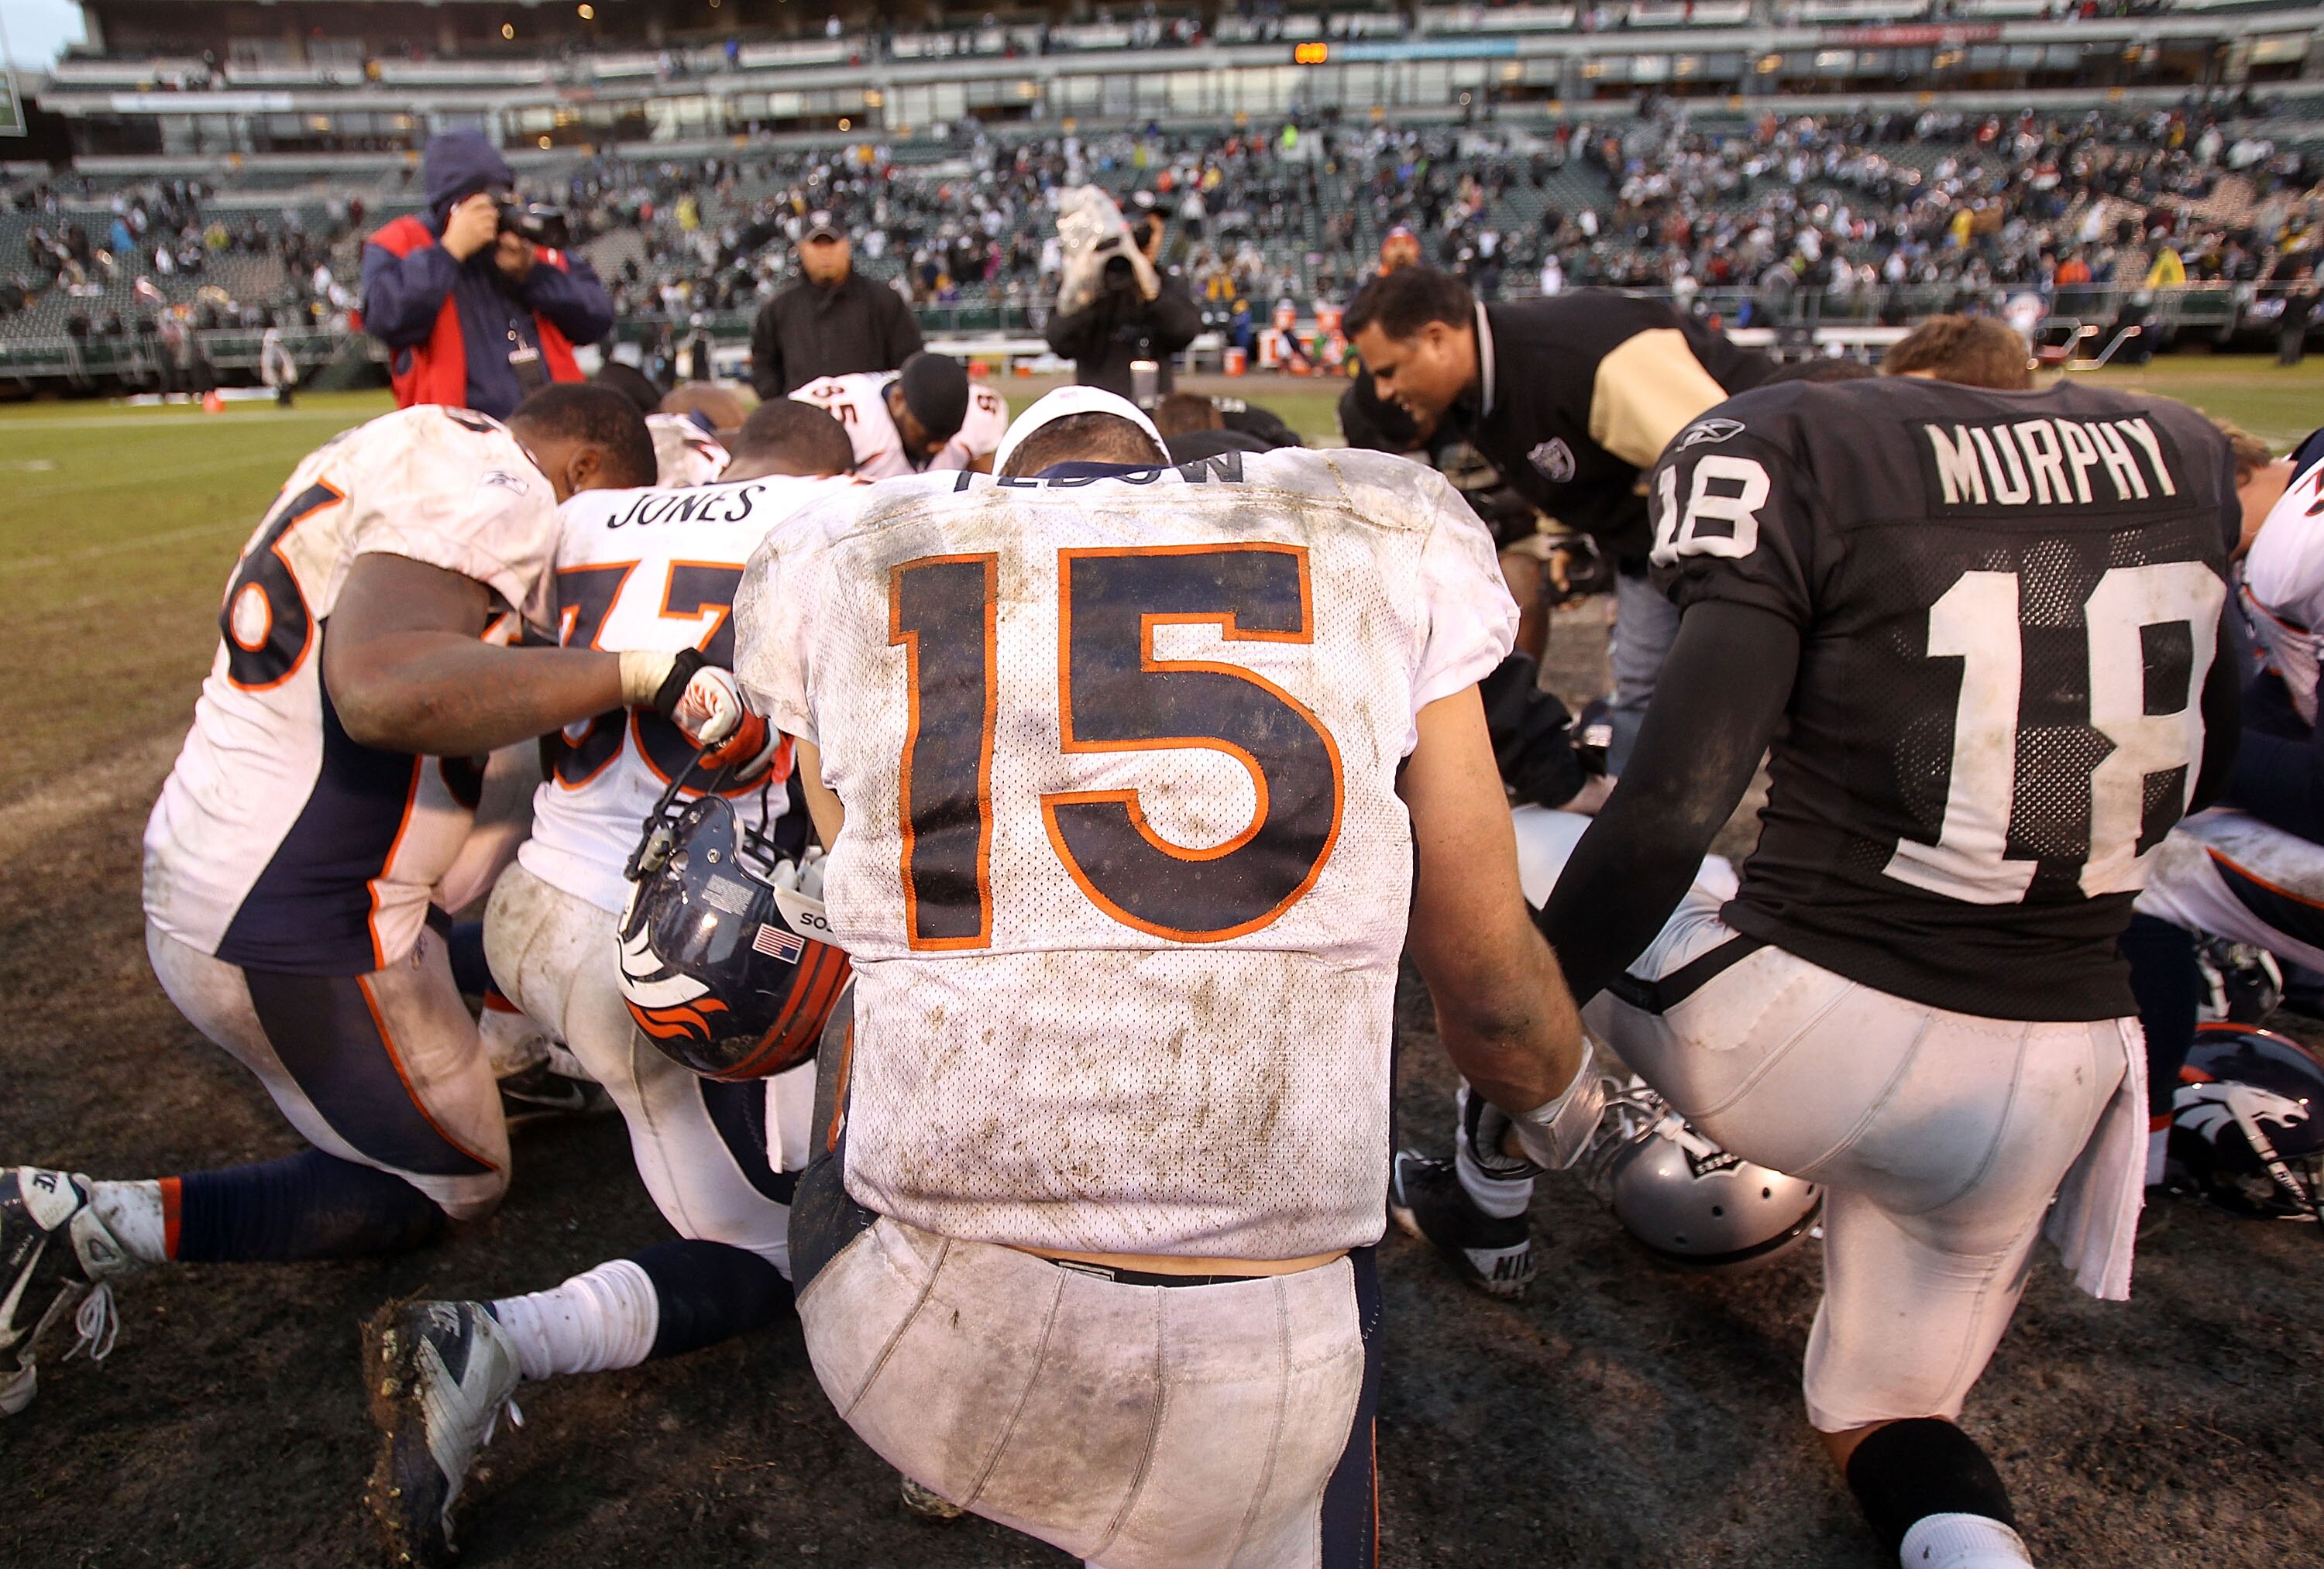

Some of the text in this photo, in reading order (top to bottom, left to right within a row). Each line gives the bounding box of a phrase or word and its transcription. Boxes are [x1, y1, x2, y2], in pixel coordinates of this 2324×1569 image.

[607, 485, 767, 529] JONES
[1648, 455, 1772, 568] 18
[1923, 417, 2177, 506] MURPHY
[889, 541, 1345, 952] 15
[1882, 560, 2227, 905] 18
